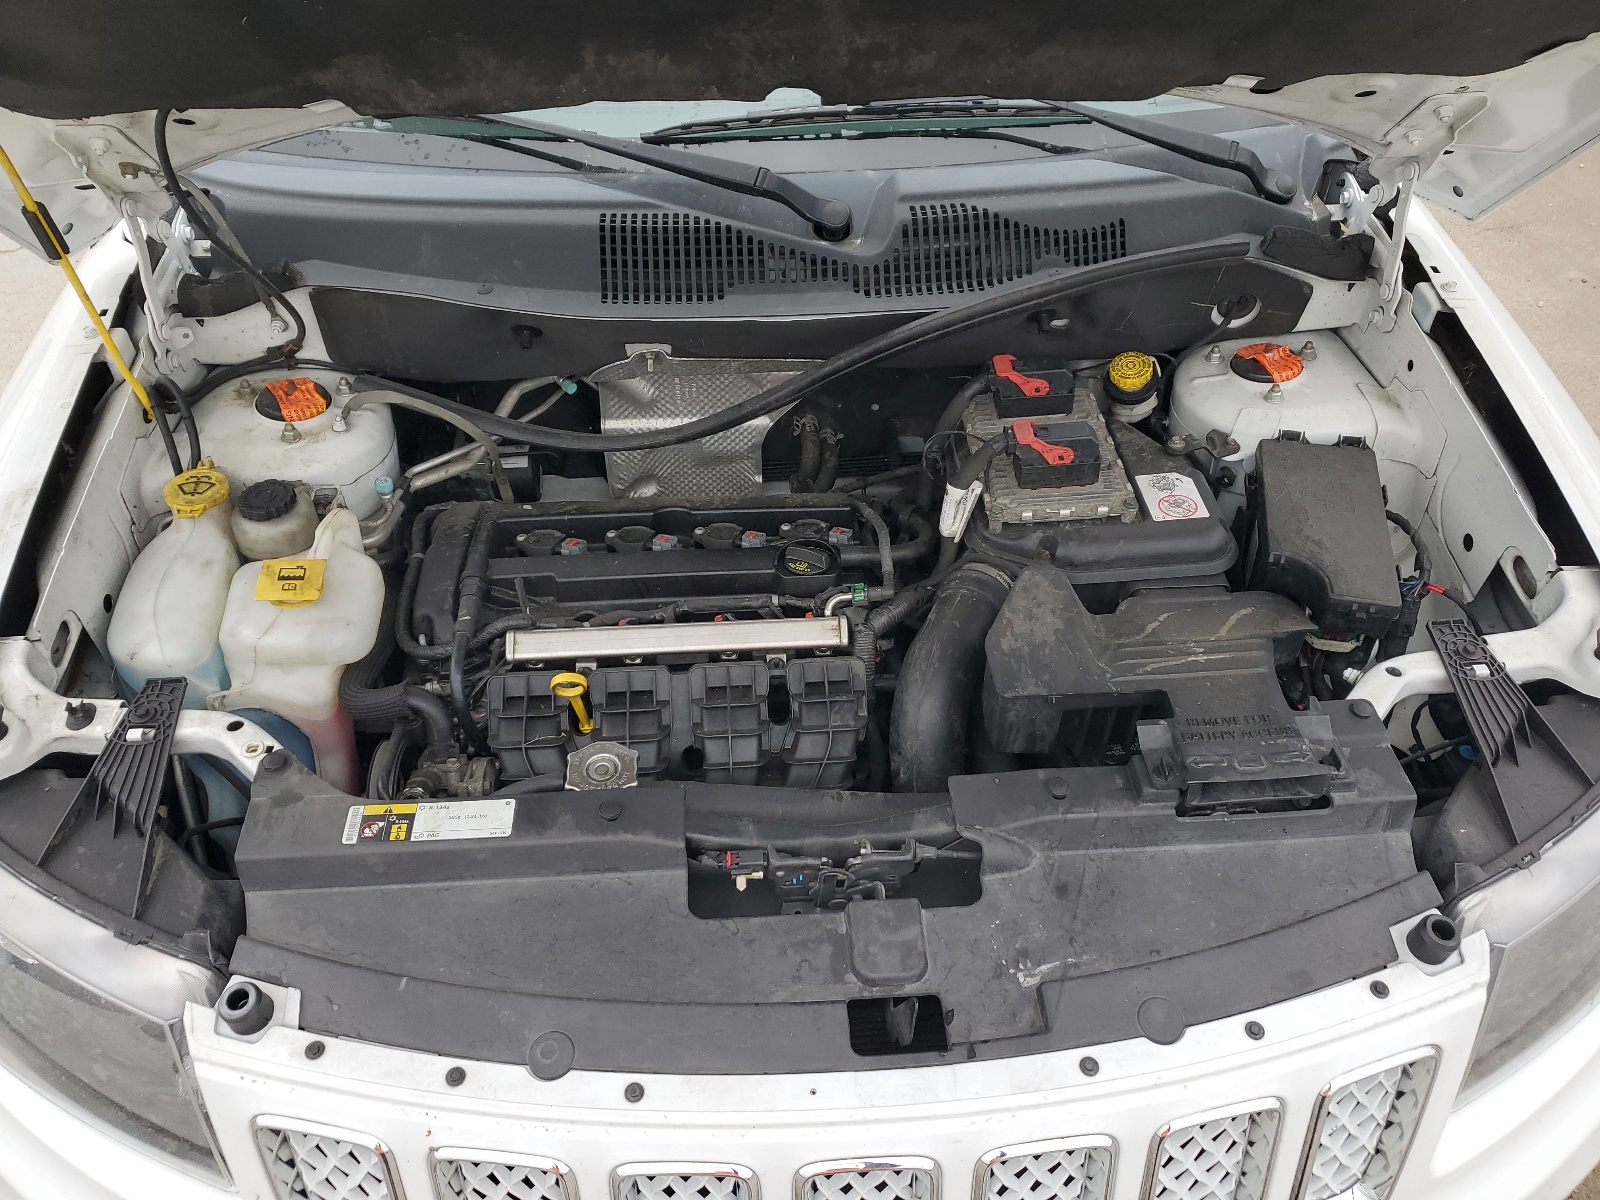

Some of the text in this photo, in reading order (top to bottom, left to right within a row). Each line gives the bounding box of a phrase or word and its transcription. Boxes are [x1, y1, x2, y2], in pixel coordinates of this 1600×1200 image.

[1185, 713, 1271, 728] REMOVE FOR
[1180, 726, 1293, 742] BATTERY ACCESS
